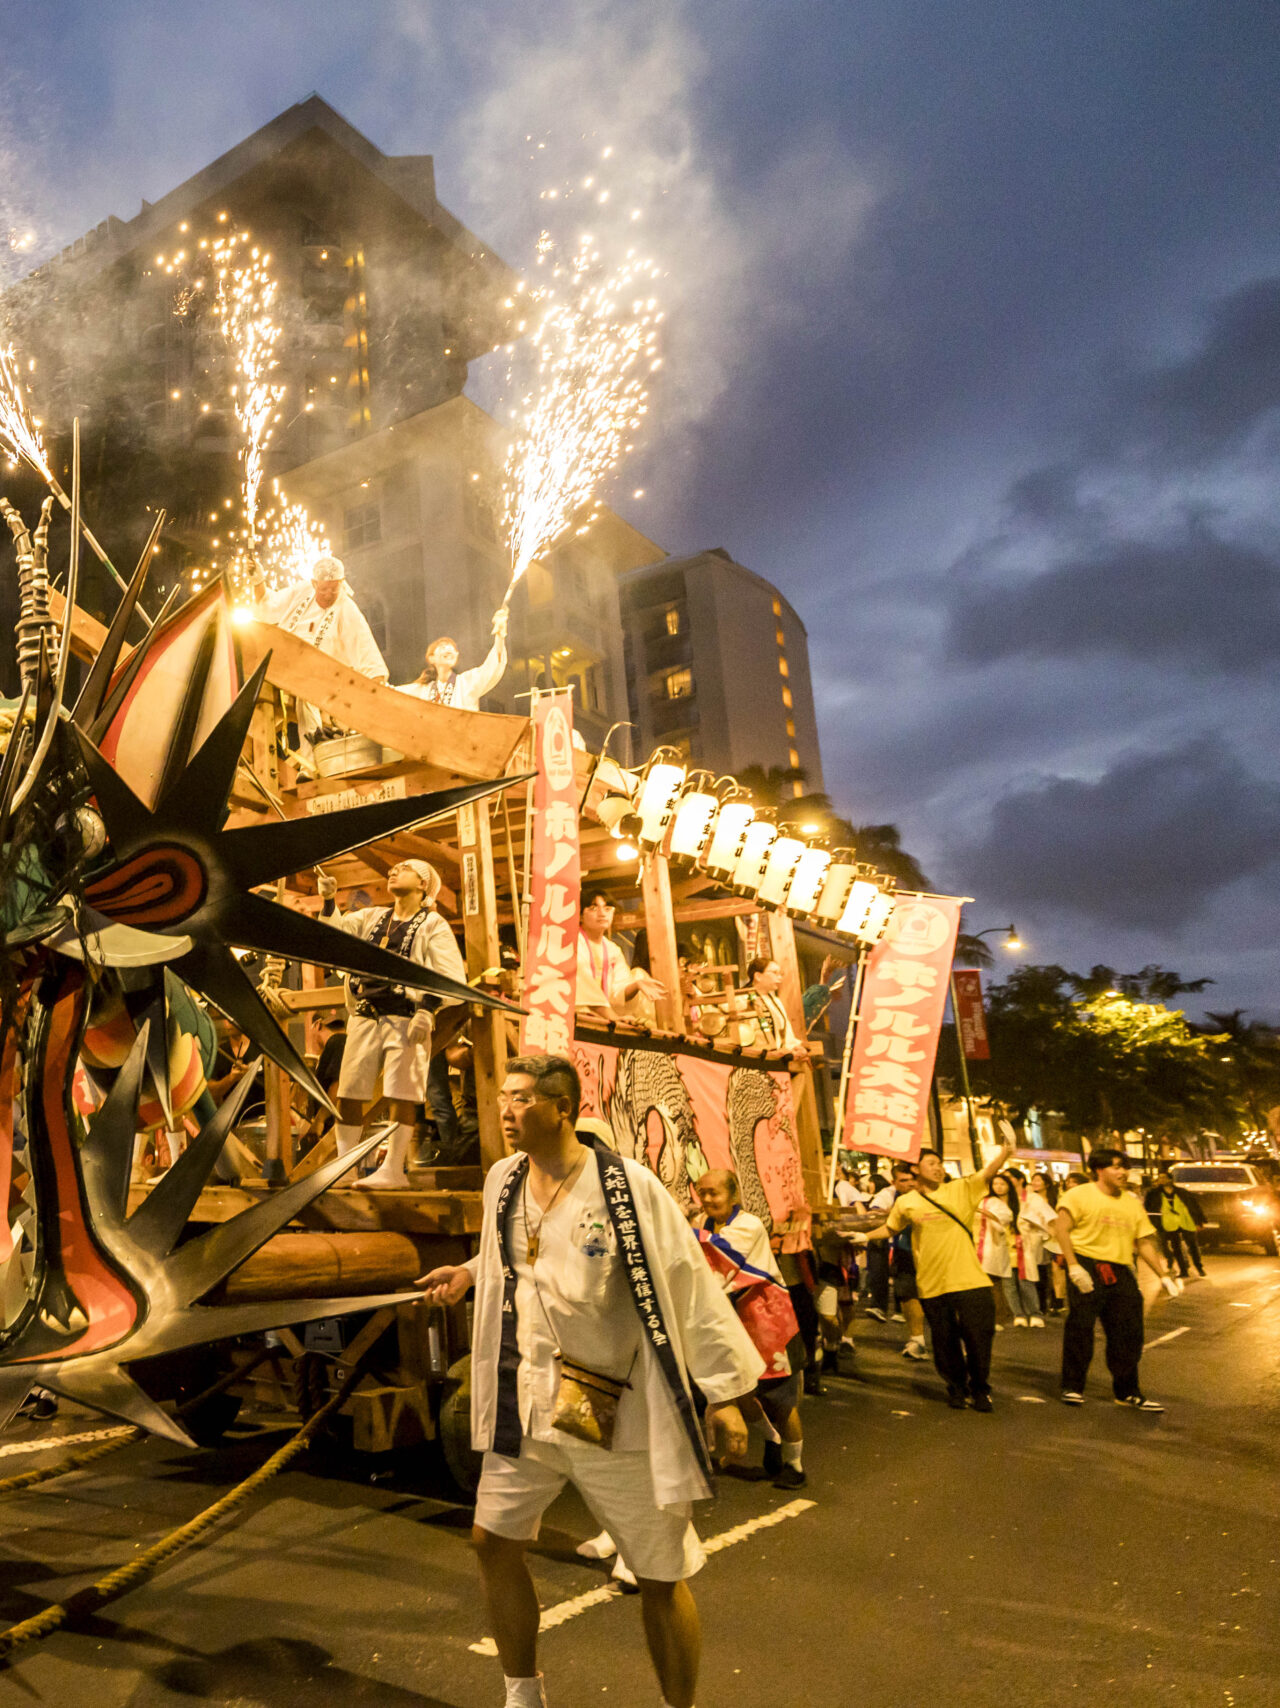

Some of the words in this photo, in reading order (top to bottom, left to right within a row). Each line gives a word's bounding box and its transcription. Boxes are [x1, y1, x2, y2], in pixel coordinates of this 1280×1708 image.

[850, 958, 939, 1153] ホノルル大蛇山
[604, 1165, 668, 1347] 大蛇山を世界に発信する会
